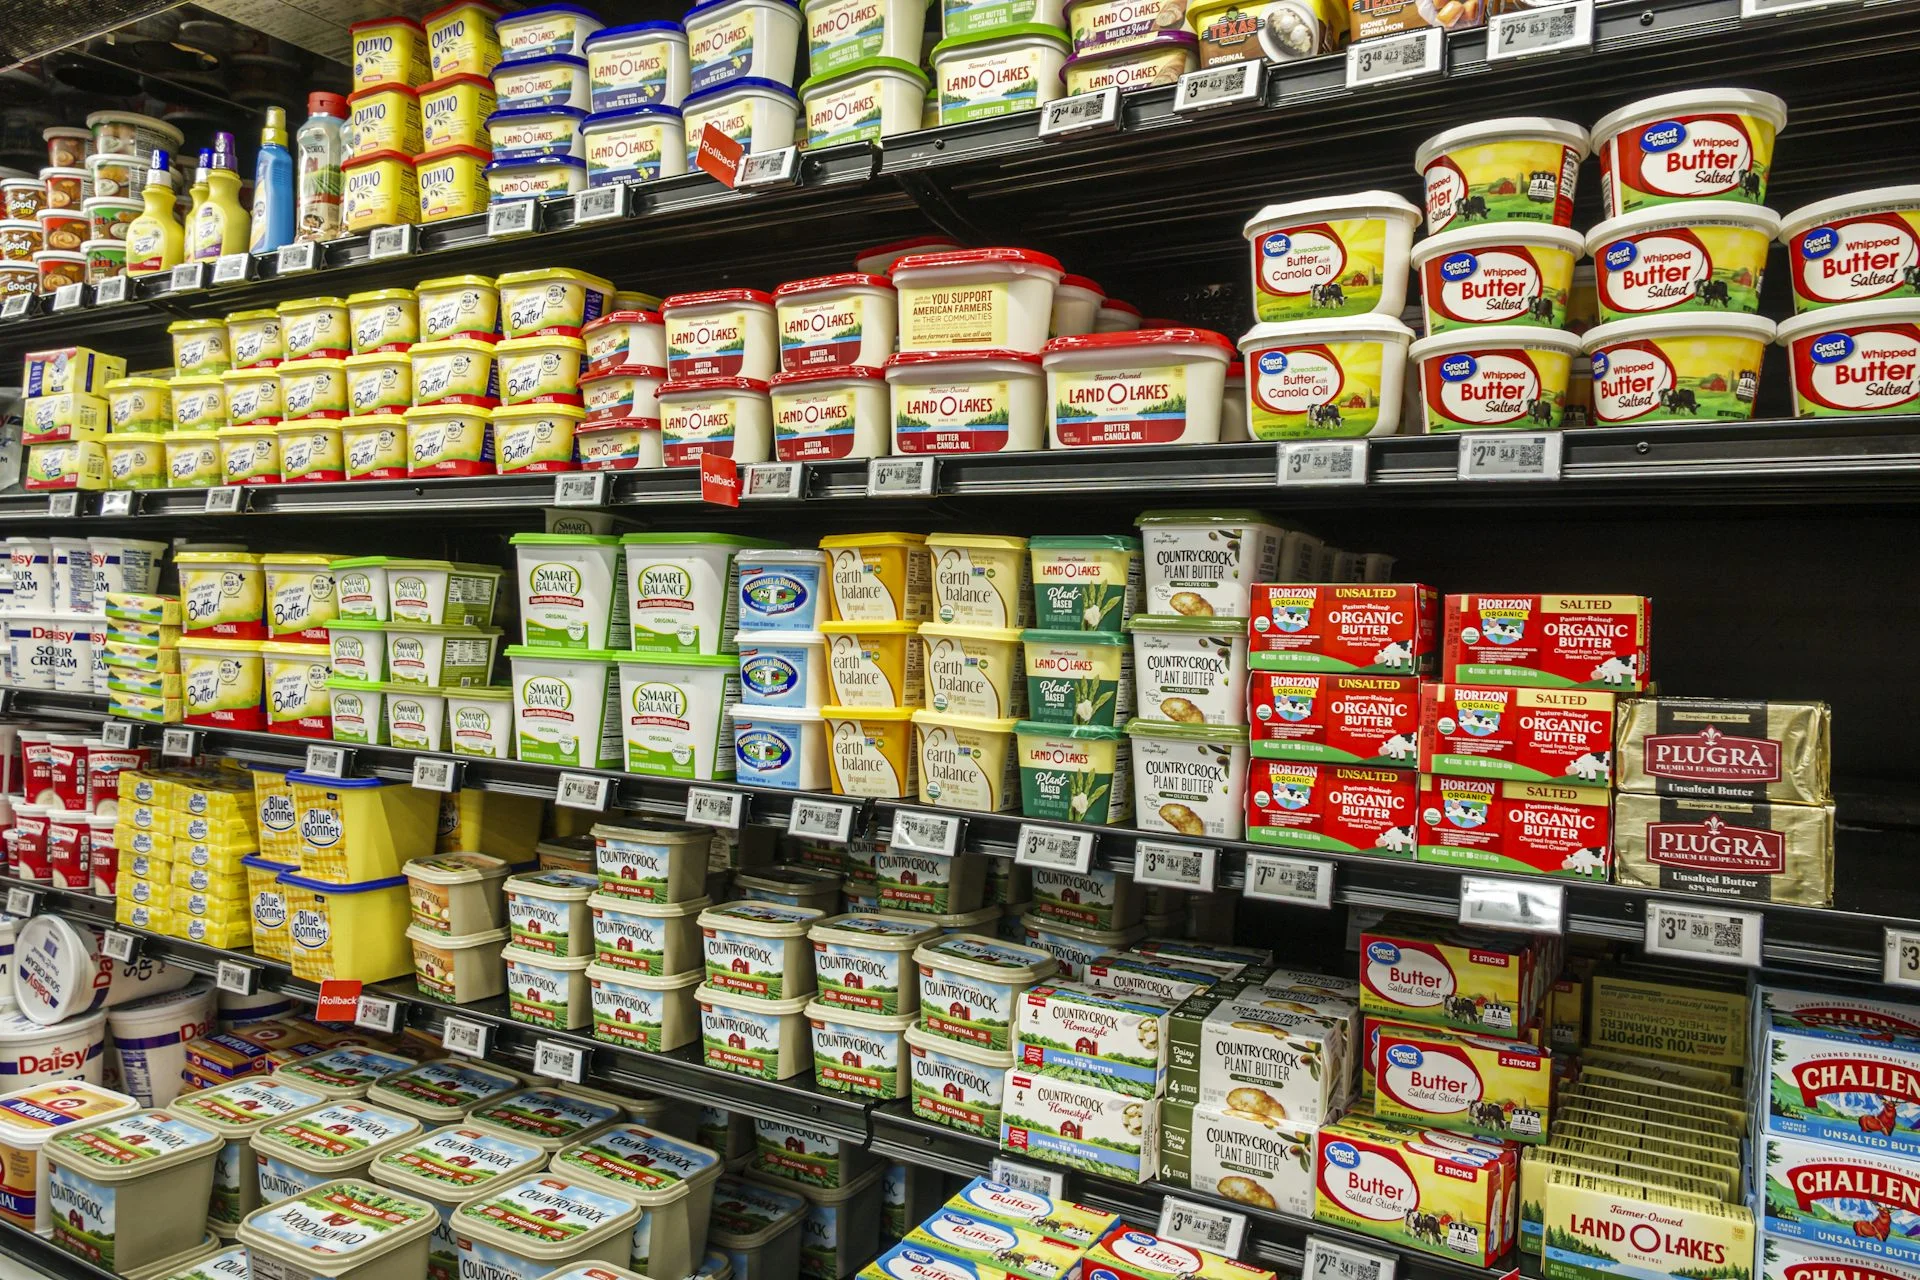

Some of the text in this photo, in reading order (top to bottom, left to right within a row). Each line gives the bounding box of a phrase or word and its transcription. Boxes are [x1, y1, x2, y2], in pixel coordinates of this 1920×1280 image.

[1093, 11, 1117, 27] LAND
[1134, 2, 1160, 17] LAKES
[1211, 18, 1255, 39] TEXAS
[1360, 21, 1381, 30] HONEY
[1360, 22, 1403, 34] CINNAMON
[432, 20, 465, 49] OLIVIO
[691, 41, 711, 56] LAND
[724, 26, 746, 43] LAKES
[1105, 29, 1124, 40] GARLIC
[356, 36, 392, 56] OLIVIO
[1209, 52, 1244, 64] ORIGINAL
[594, 65, 618, 77] LAND
[634, 58, 660, 71] LAKES
[946, 72, 976, 91] LAND
[996, 65, 1029, 83] LAKES
[425, 95, 458, 119] OLIVIO
[810, 111, 832, 126] LAND
[848, 96, 874, 115] LAKES
[354, 103, 386, 126] OLIVIO
[1644, 128, 1678, 142] Great
[1652, 137, 1677, 147] Value
[1693, 139, 1739, 149] Whipped
[702, 140, 736, 170] Rollback
[1667, 150, 1737, 173] Butter
[1695, 170, 1734, 184] Salted
[1264, 239, 1286, 248] Great
[1804, 234, 1830, 250] Great
[1810, 242, 1831, 253] Value
[1846, 237, 1899, 250] Whipped
[1287, 255, 1317, 267] Butter
[1607, 248, 1630, 260] Great
[1612, 255, 1630, 264] Value
[1643, 252, 1691, 263] Whipped
[1273, 265, 1330, 279] Canola Oil
[1444, 261, 1471, 270] Great
[1823, 252, 1899, 278] Butter
[1483, 269, 1526, 277] Whipped
[1624, 266, 1690, 288] Butter
[1851, 270, 1897, 286] Salted
[7, 282, 37, 293] Good!
[1462, 279, 1525, 299] Butter
[1647, 283, 1687, 298] Salted
[932, 291, 992, 305] YOU SUPPORT
[1486, 299, 1522, 311] Salted
[913, 302, 992, 314] AMERICAN FARMERS
[511, 302, 545, 329] Butter!
[922, 313, 992, 323] THEIR COMMUNITIES
[785, 317, 809, 334] LAND
[827, 312, 854, 327] LAKES
[1814, 340, 1845, 352] Great
[1821, 348, 1845, 357] Value
[1862, 349, 1916, 359] Whipped
[1835, 362, 1915, 384] Butter
[1070, 388, 1104, 404] LAND
[1130, 384, 1168, 399] LAKES
[1866, 382, 1912, 396] Salted
[908, 399, 937, 413] LAND
[959, 398, 992, 412] LAKES
[1104, 424, 1129, 432] BUTTER
[1131, 432, 1142, 440] OIL
[704, 472, 735, 488] Rollback
[537, 571, 572, 581] SMART
[836, 570, 861, 585] earth
[940, 571, 969, 586] earth
[536, 580, 576, 593] BALANCE
[841, 584, 880, 600] balance
[1269, 588, 1316, 598] HORIZON
[1336, 588, 1396, 598] UNSALTED
[946, 587, 991, 602] balance
[188, 591, 221, 621] Butter!
[274, 596, 311, 625] Butter!
[1053, 599, 1072, 608] BASED
[1478, 599, 1532, 610] HORIZON
[1560, 600, 1612, 609] SALTED
[1328, 611, 1403, 624] ORGANIC
[1342, 625, 1388, 635] BUTTER
[1544, 624, 1628, 637] ORGANIC
[1559, 637, 1611, 648] BUTTER
[1155, 669, 1214, 685] PLANT BUTTER
[1656, 764, 1700, 773] PREMIUM
[1700, 766, 1739, 774] EUROPEAN
[1668, 783, 1754, 797] Unsalted Butter
[310, 809, 330, 823] Blue
[304, 821, 339, 837] Bonnet
[1706, 886, 1740, 895] Butterfat
[727, 978, 754, 989] ORIGINAL
[321, 996, 356, 1004] Rollback
[840, 995, 867, 1006] ORIGINAL
[20, 1045, 87, 1075] Daisy
[11, 1102, 60, 1121] IMPERIAL
[1048, 1102, 1093, 1121] Homestyle
[1165, 1131, 1187, 1145] Dairy
[1168, 1140, 1183, 1152] Free
[1329, 1146, 1354, 1159] Great
[1335, 1156, 1354, 1164] Value
[422, 1162, 455, 1177] ORIGINAL
[1162, 1165, 1188, 1179] 4 STICKS
[1444, 1167, 1473, 1179] STICKS
[1348, 1171, 1404, 1200] Butter
[1345, 1190, 1402, 1213] Salted Sticks
[1611, 1205, 1683, 1227] Farmer-Owned
[1571, 1214, 1624, 1242] LAND
[1666, 1234, 1725, 1264] LAKES
[1818, 1231, 1881, 1252] UNSALTED
